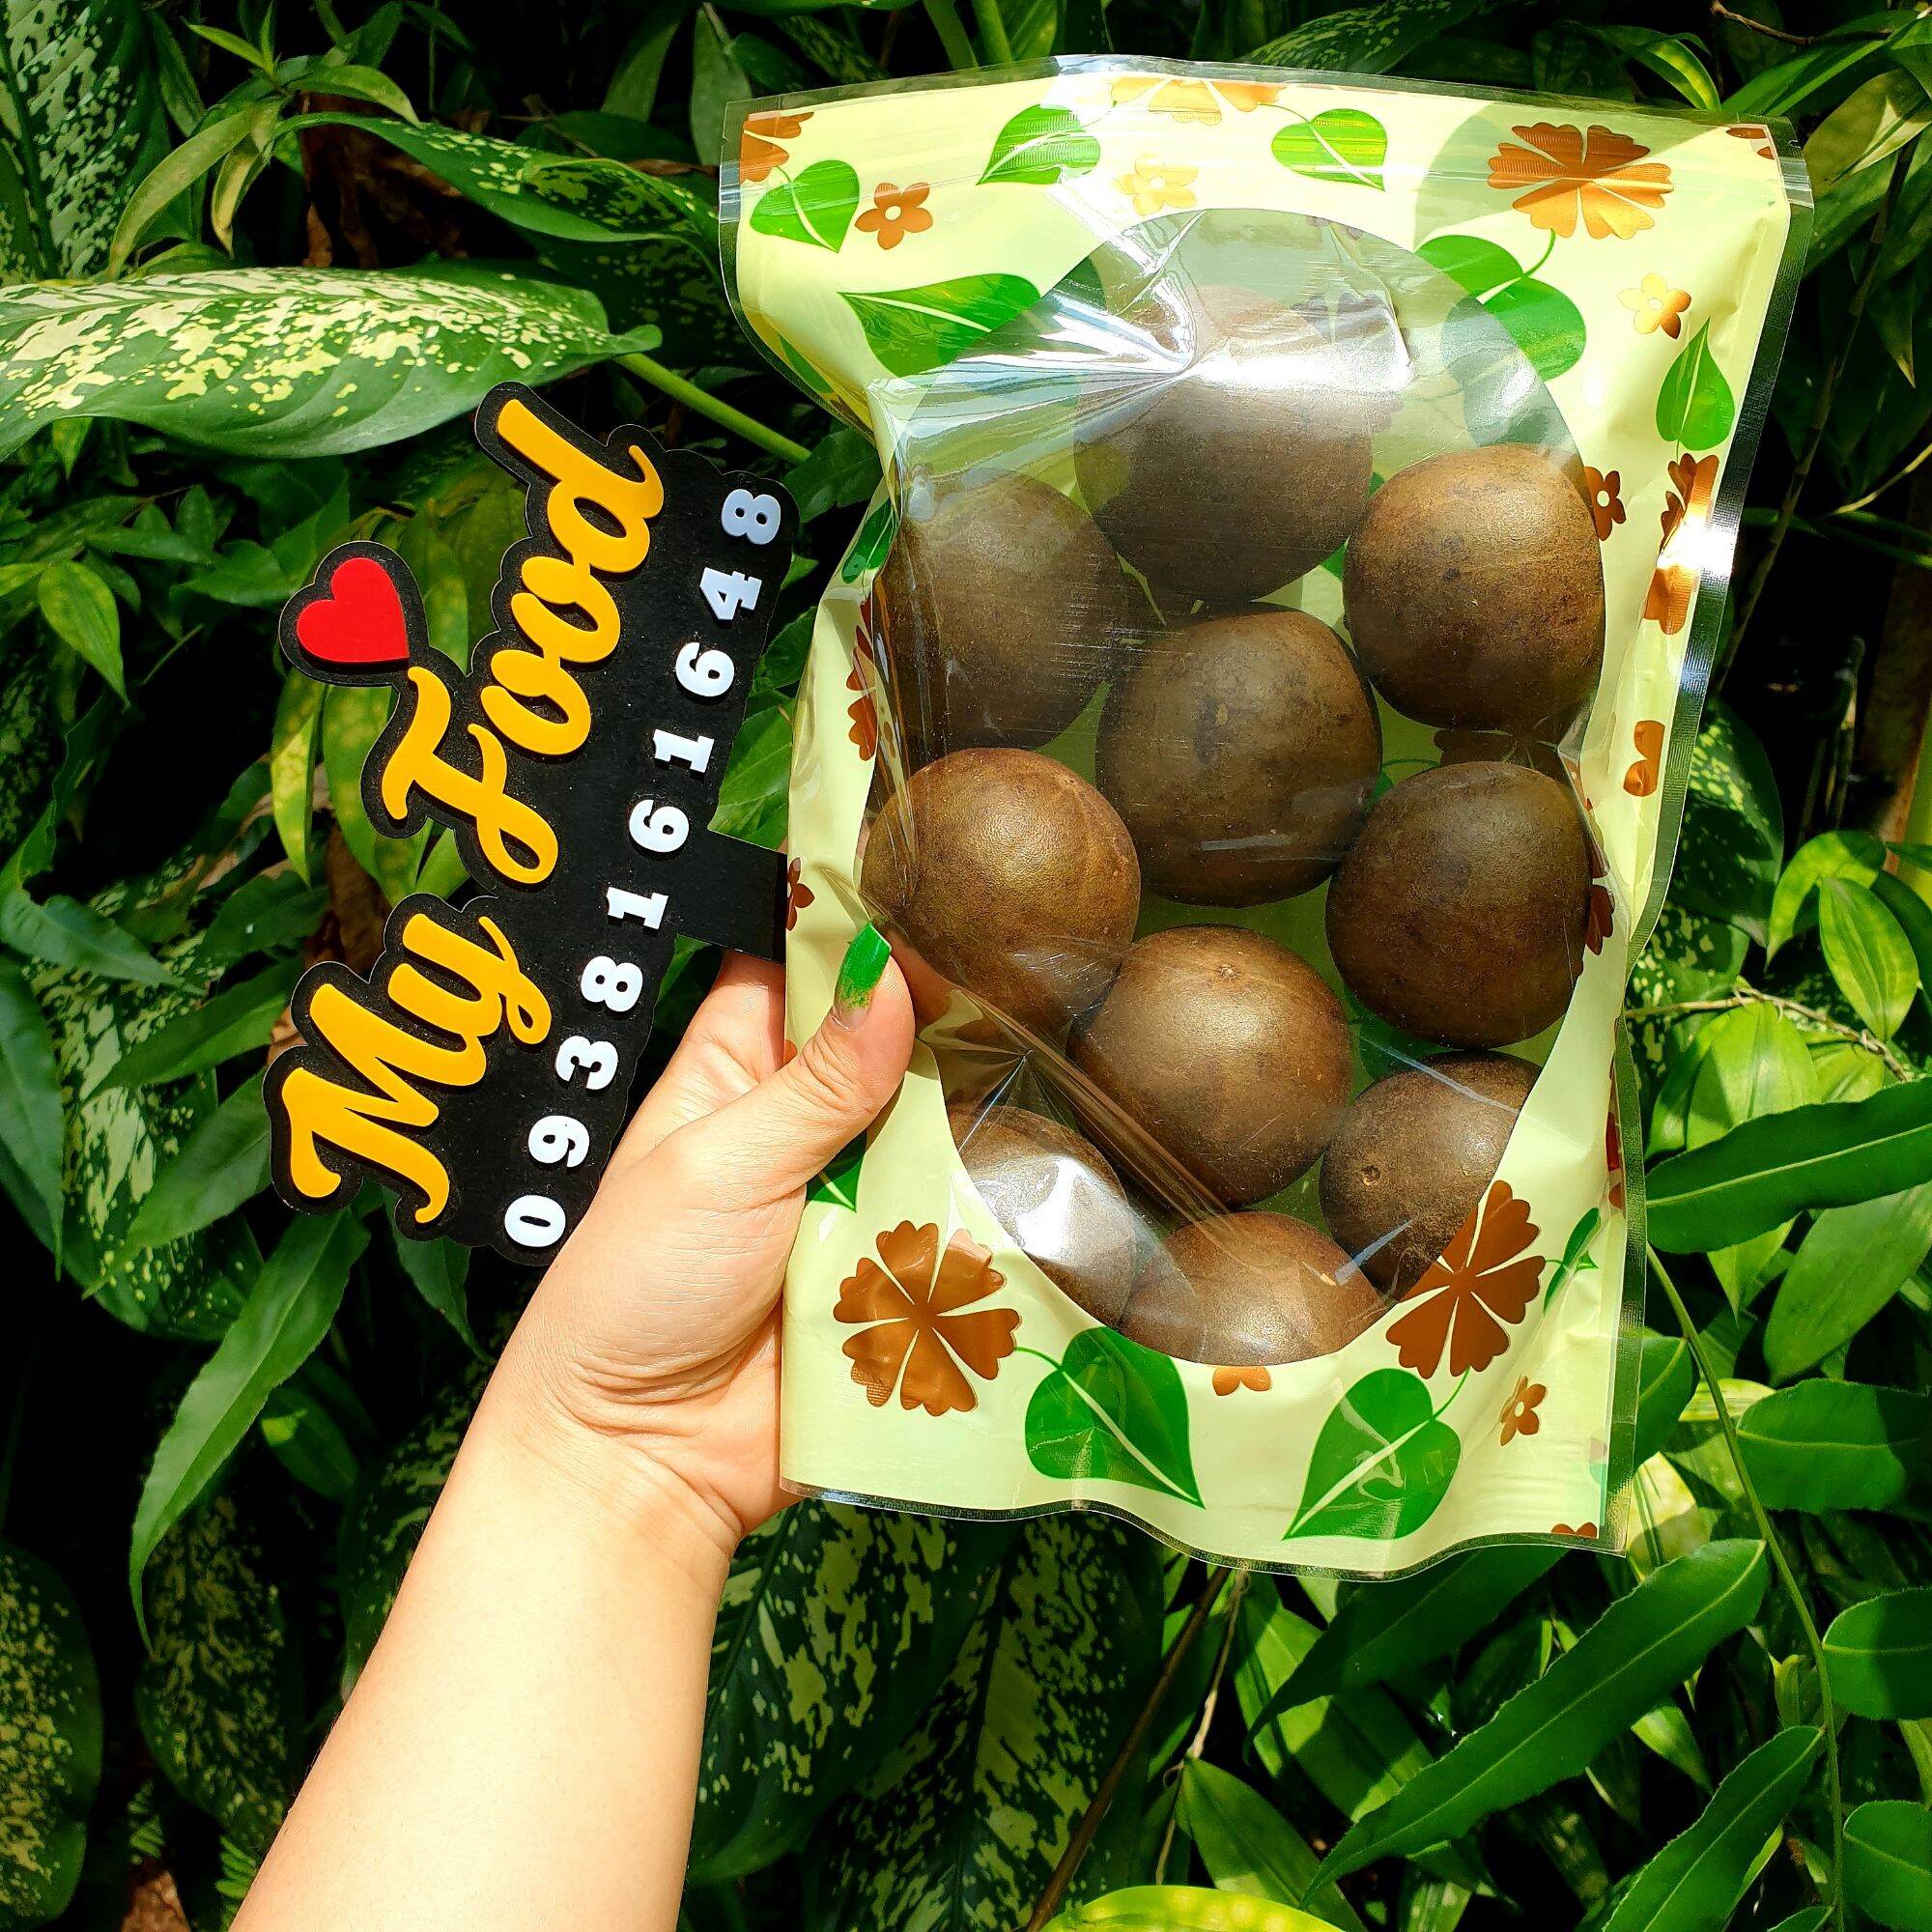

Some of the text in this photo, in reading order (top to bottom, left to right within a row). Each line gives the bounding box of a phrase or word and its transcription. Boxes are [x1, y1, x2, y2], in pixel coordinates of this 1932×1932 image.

[281, 397, 664, 1224] My Food
[504, 487, 781, 1248] 0938161648
